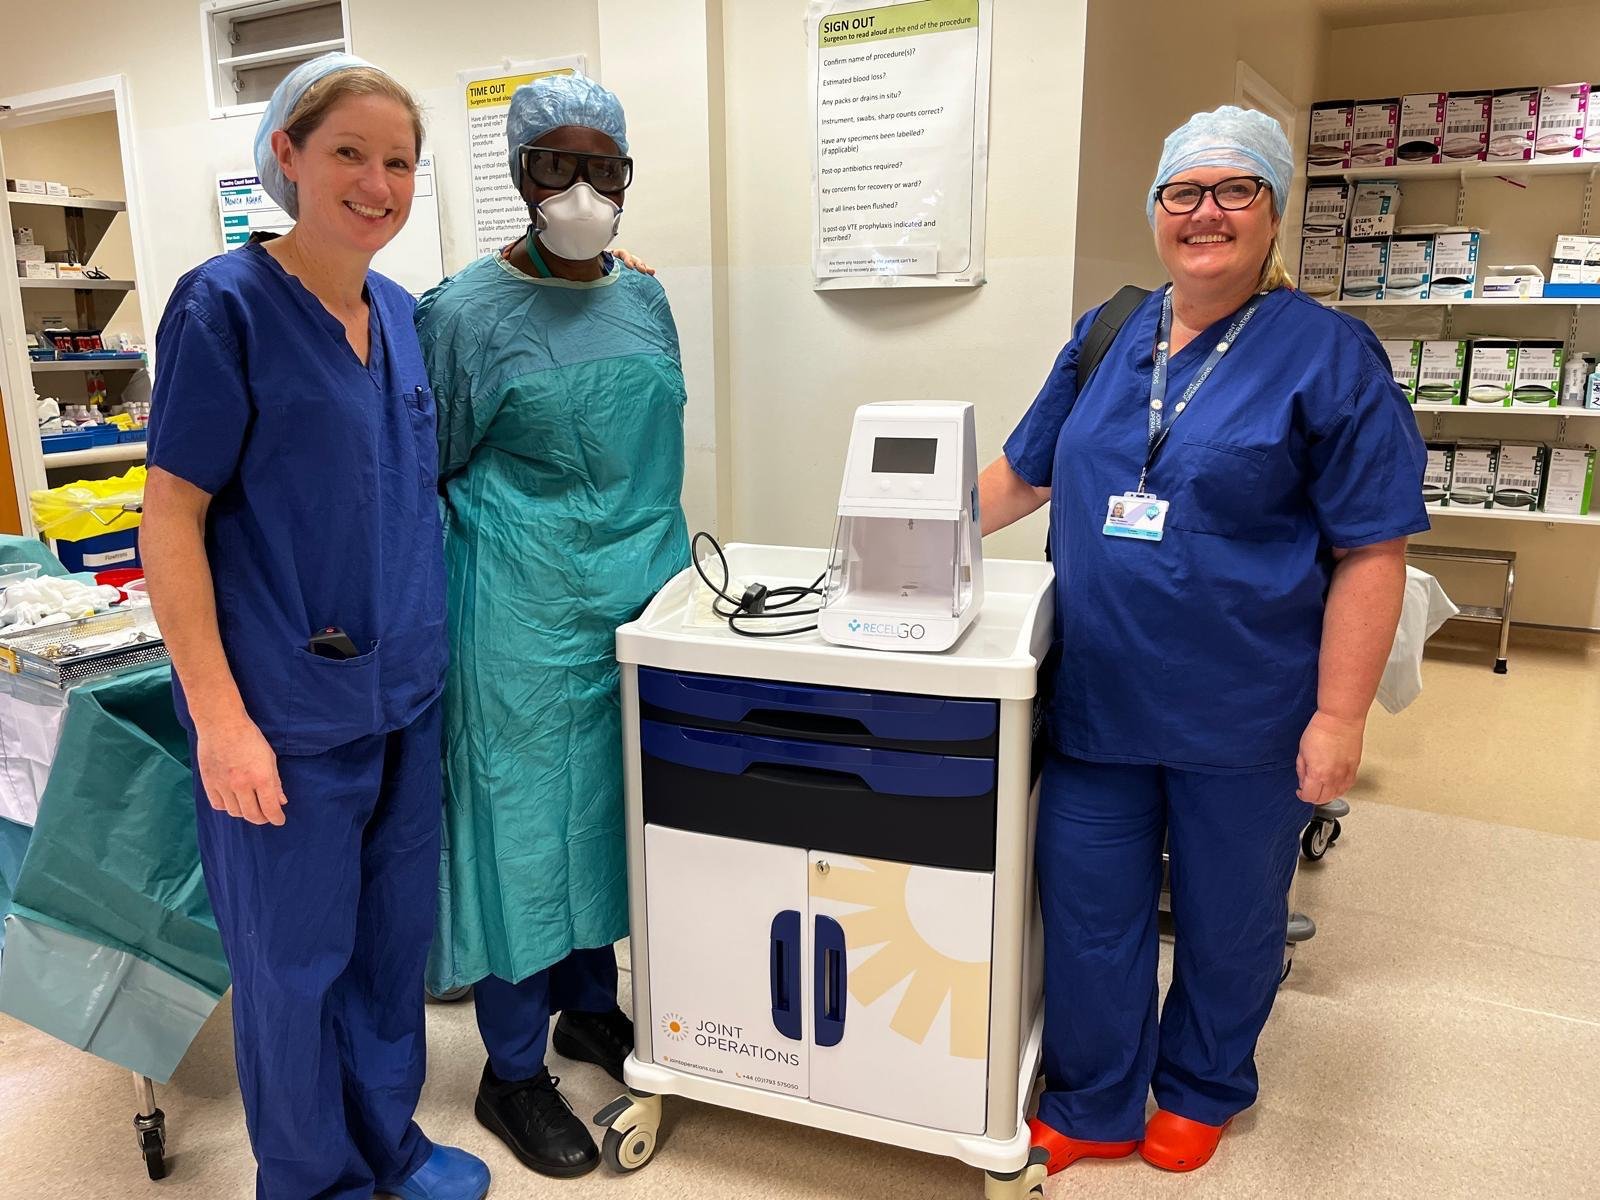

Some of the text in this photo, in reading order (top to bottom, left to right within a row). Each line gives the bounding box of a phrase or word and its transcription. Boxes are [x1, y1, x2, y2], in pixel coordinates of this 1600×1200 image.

[823, 34, 847, 43] Surgeon
[856, 30, 869, 38] read
[871, 28, 887, 37] aloud
[940, 17, 971, 28] procedure
[824, 16, 875, 33] SIGN OUT
[823, 56, 847, 66] Confirm
[848, 55, 864, 63] name
[873, 48, 916, 60] procedure(s)?
[823, 76, 851, 86] Estimated
[853, 74, 869, 82] blood
[470, 84, 505, 97] TIME OUT
[835, 96, 851, 105] packs
[860, 93, 878, 102] drains
[822, 107, 943, 125] Instrument, swabs, sharp counts correct?
[836, 136, 846, 144] any
[848, 133, 878, 143] specimens
[897, 129, 924, 138] labelled?
[828, 145, 858, 155] applicable)
[842, 164, 872, 173] antibiotics
[874, 162, 902, 171] required?
[832, 184, 856, 193] concerns
[867, 182, 893, 191] recovery
[827, 225, 846, 233] post-op
[859, 222, 892, 231] prophylaxis
[823, 234, 851, 243] prescribed?
[1226, 323, 1237, 339] JOINT
[1229, 307, 1255, 342] OPERATIONS
[1183, 383, 1194, 399] JOINT
[1186, 367, 1212, 401] OPERATIONS
[696, 1019, 743, 1038] JOINT
[695, 1034, 799, 1066] OPERATIONS
[669, 1057, 723, 1074] jointoperations.co.uk
